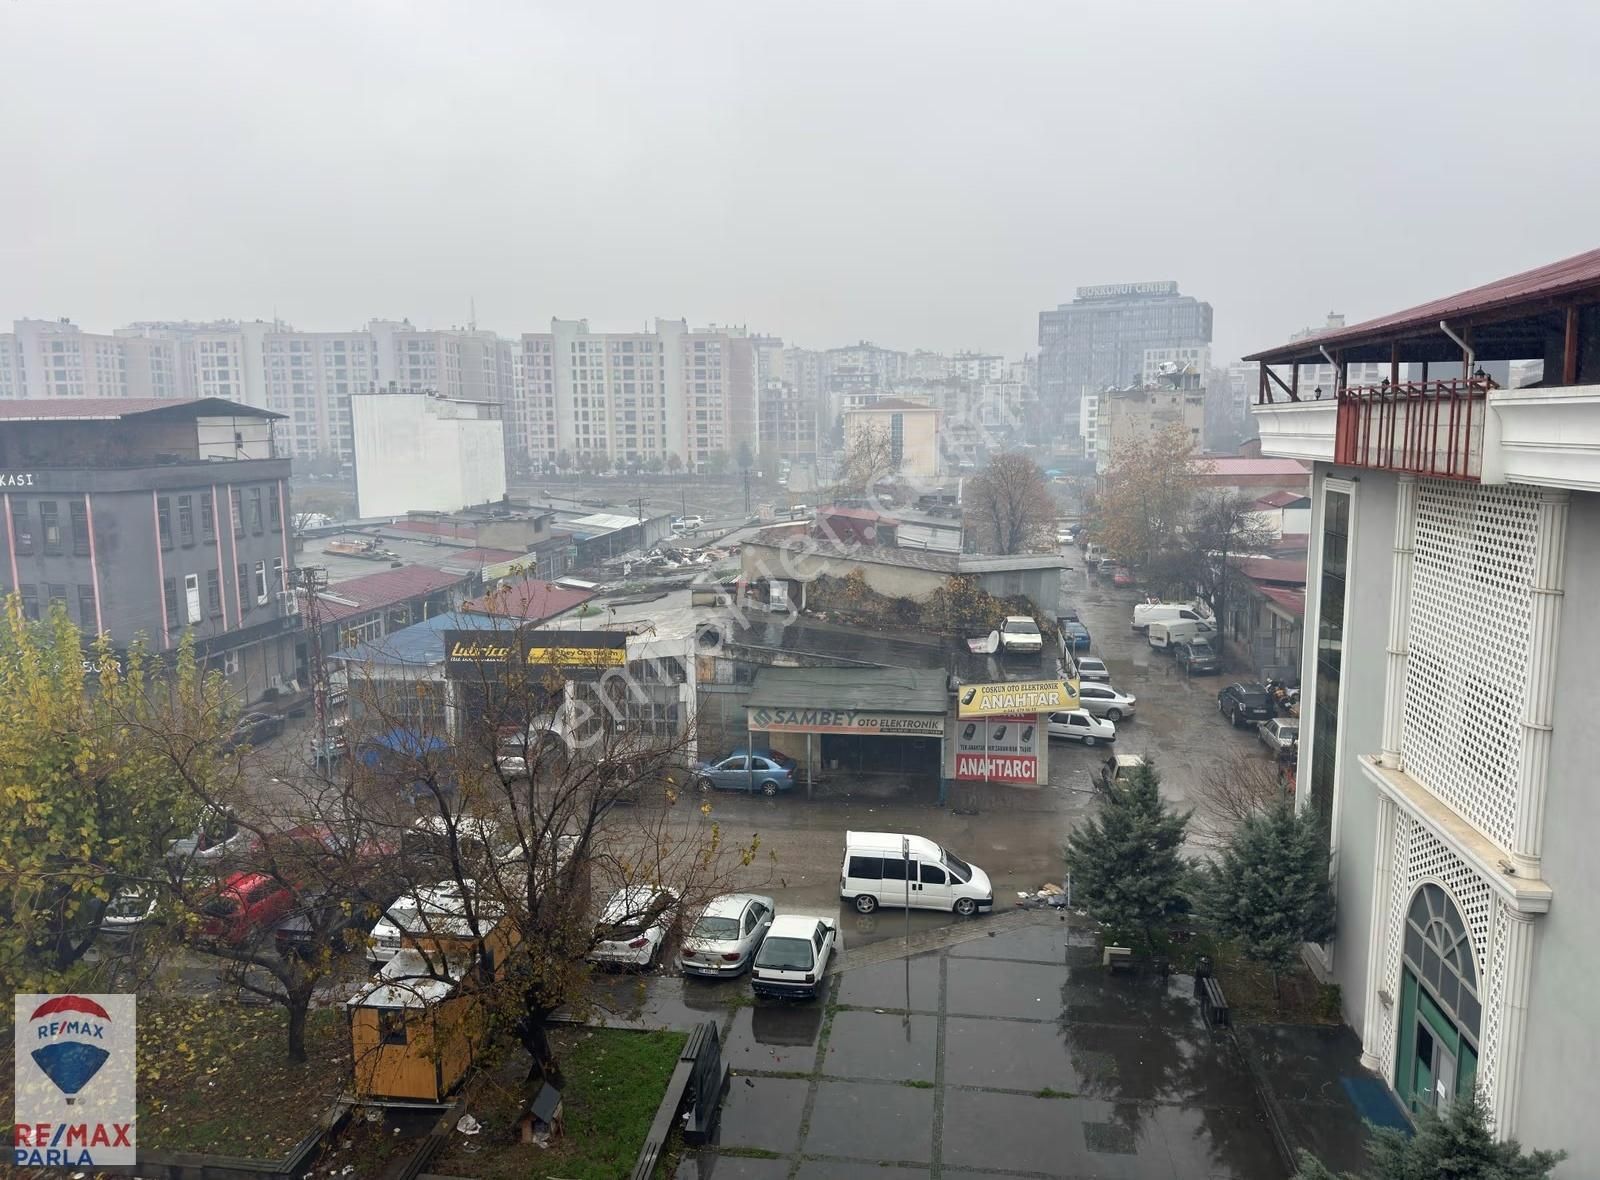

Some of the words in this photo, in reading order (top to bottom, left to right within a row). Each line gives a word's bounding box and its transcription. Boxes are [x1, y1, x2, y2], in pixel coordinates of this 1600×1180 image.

[1007, 684, 1020, 692] OTO
[979, 692, 1060, 709] ANAHTAR
[773, 710, 858, 727] SAMBEY
[857, 719, 877, 727] OTO
[959, 757, 1036, 778] ANAHTARCI
